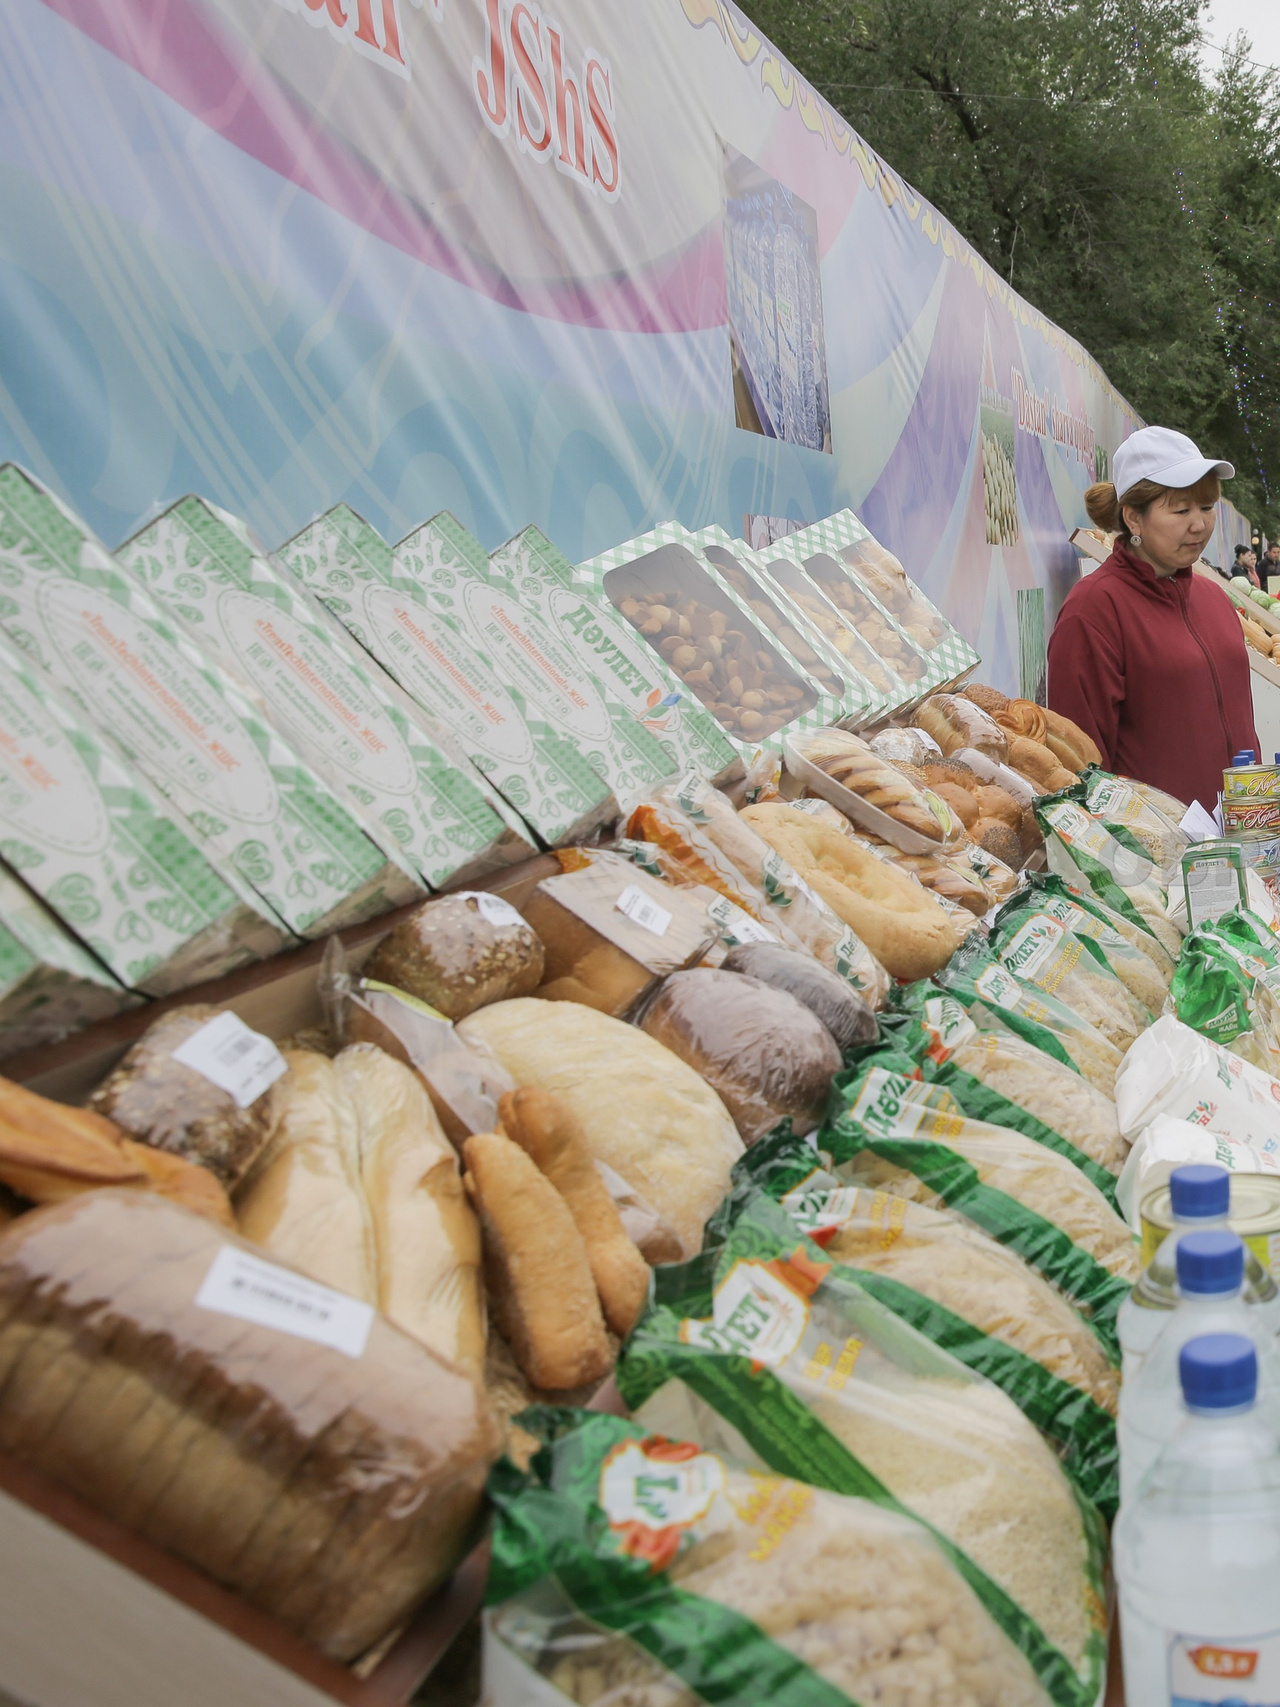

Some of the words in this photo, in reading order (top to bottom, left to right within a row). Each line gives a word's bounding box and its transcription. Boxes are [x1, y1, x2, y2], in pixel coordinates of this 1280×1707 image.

[476, 0, 620, 193] JShS
[396, 608, 480, 700] «TransTechInternational»
[483, 702, 504, 724] ЖШС
[492, 606, 569, 686] «TransTechInternational»
[568, 689, 587, 708] ЖШС
[560, 604, 653, 697] ДӘУЛЕТ
[360, 727, 385, 753] ЖШС
